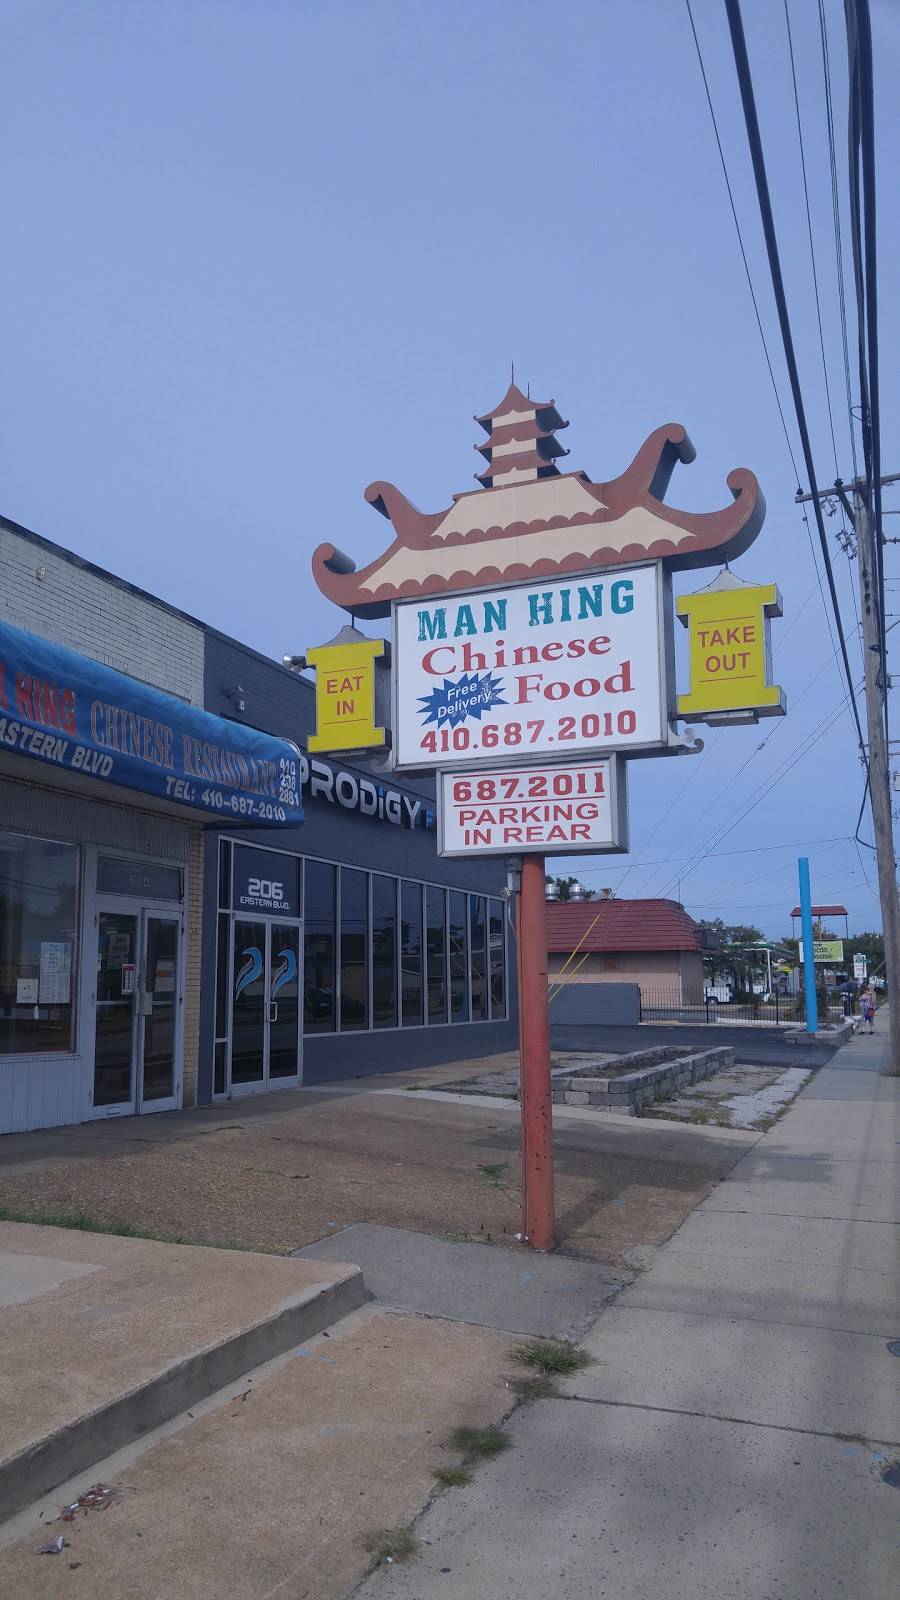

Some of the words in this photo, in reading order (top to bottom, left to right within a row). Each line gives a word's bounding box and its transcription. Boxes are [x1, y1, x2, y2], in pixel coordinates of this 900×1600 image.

[417, 599, 508, 641] MAN
[527, 580, 634, 626] HING
[697, 625, 756, 648] TAKE
[421, 635, 612, 675] Chinese
[705, 652, 750, 673] OUT
[326, 676, 364, 694] EAT
[447, 681, 478, 703] Free
[513, 660, 635, 704] Food
[336, 700, 355, 716] IN
[437, 690, 491, 719] Delivery
[420, 710, 637, 753] 410.687.2010
[71, 745, 113, 776] BLVD
[90, 700, 174, 769] CHINESE
[183, 735, 277, 798] RESTAURANT
[280, 758, 296, 776] 410
[280, 774, 296, 791] 238
[453, 772, 605, 802] 687.2011
[166, 776, 195, 800] TEL:
[201, 788, 286, 821] 410-687-2010
[279, 787, 299, 806] 2881
[459, 803, 599, 827] PARKING
[464, 829, 491, 846] IN
[503, 824, 592, 843] REAR
[248, 877, 283, 900] 206
[240, 896, 272, 908] EASTERN
